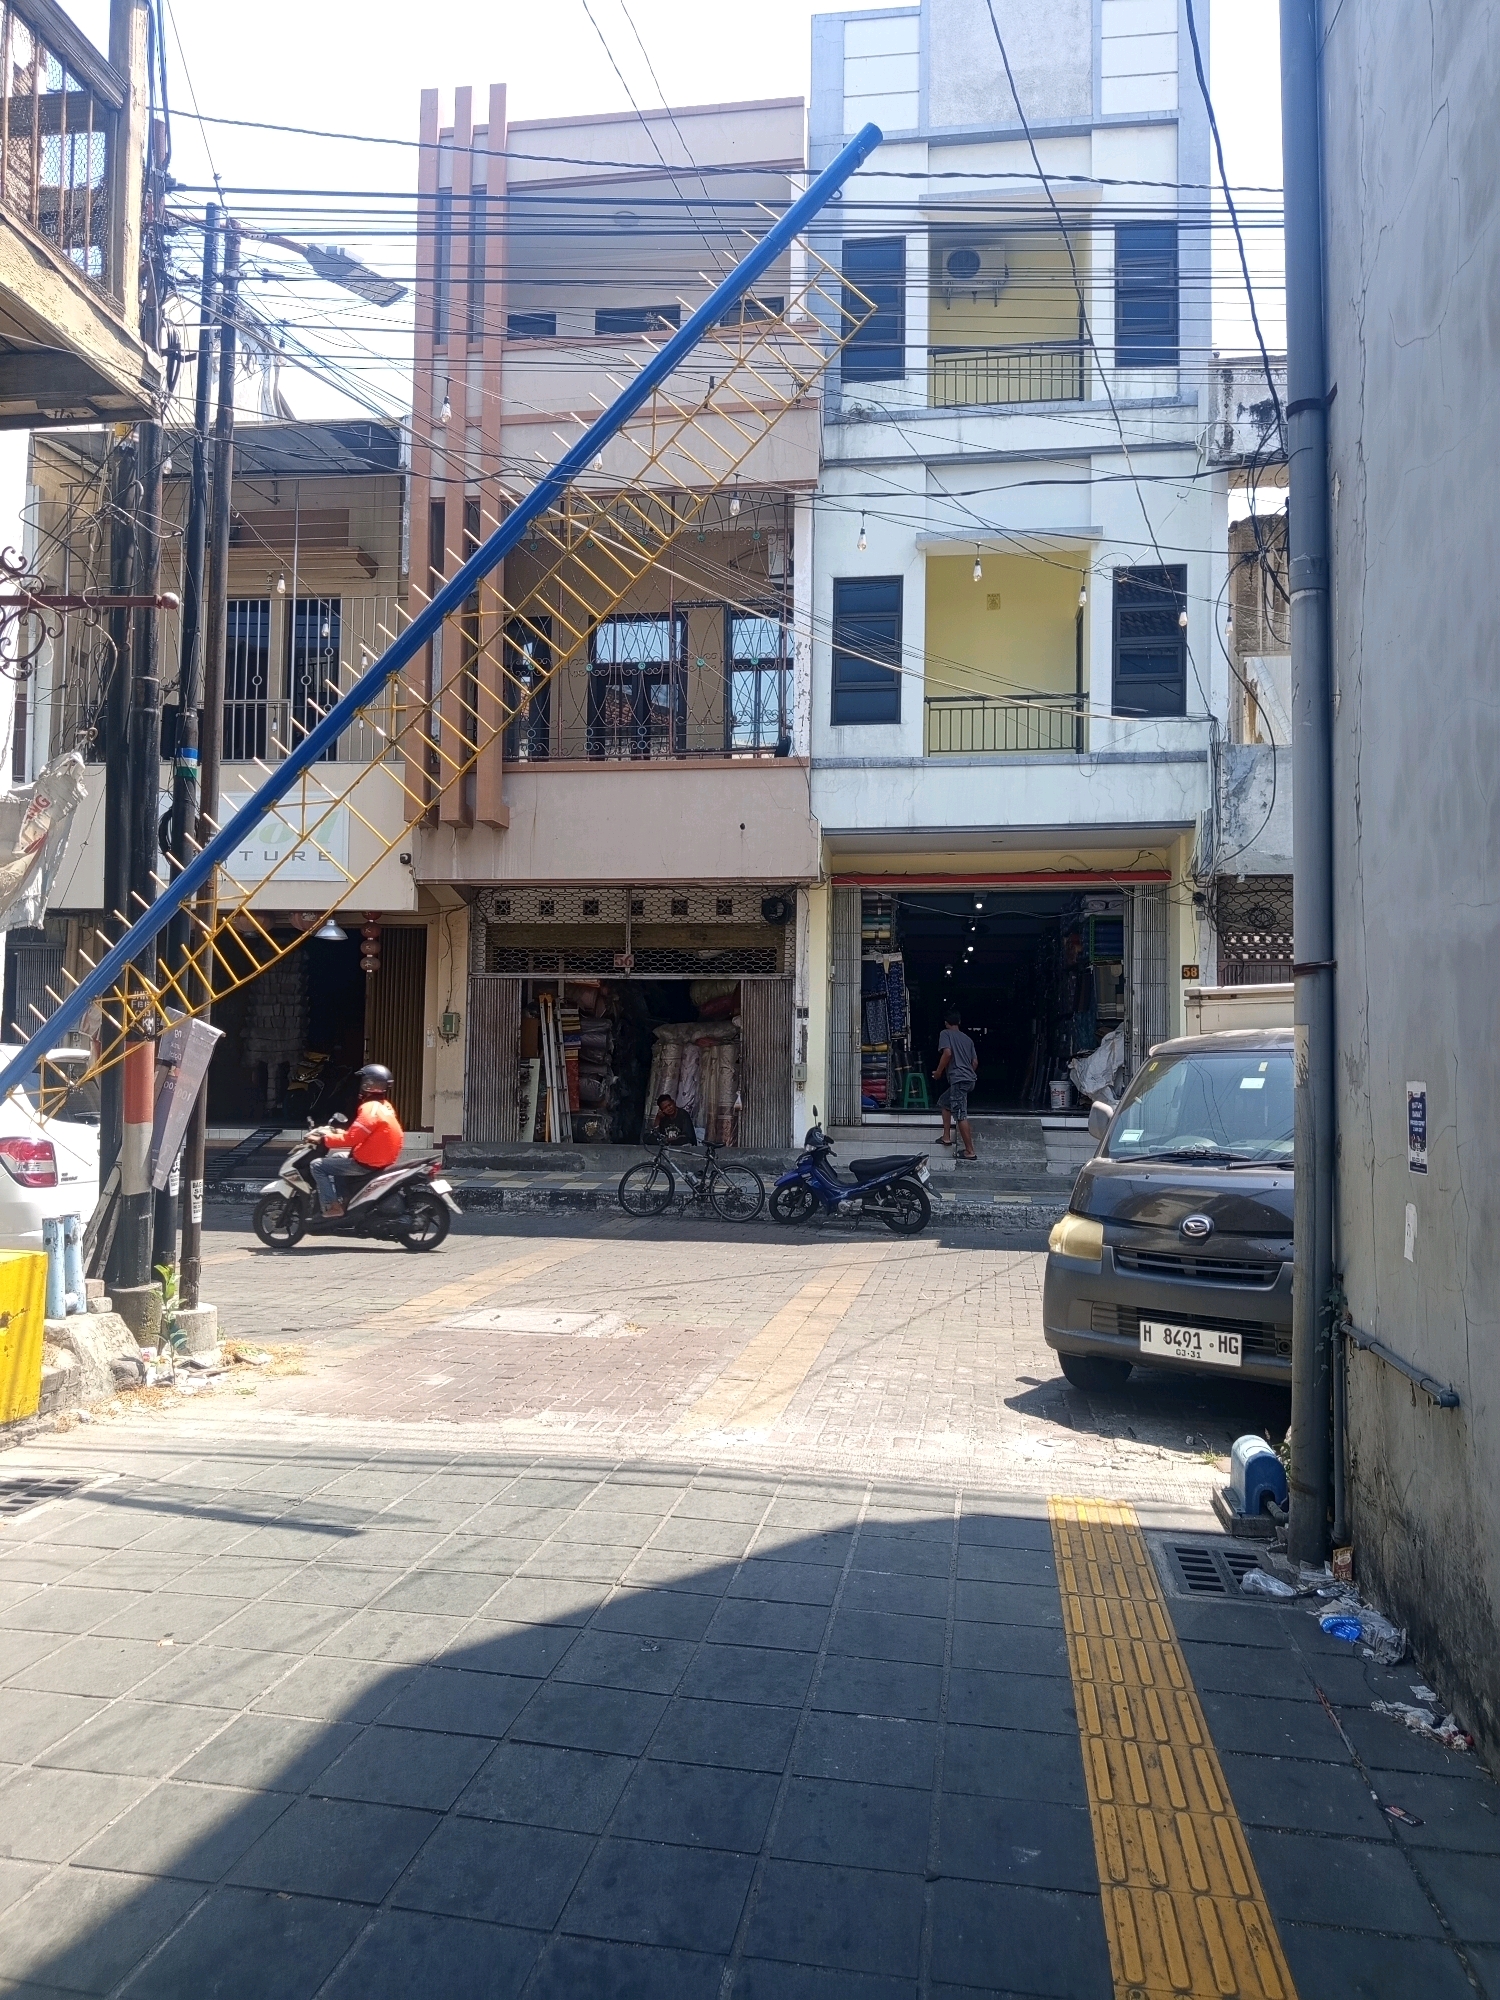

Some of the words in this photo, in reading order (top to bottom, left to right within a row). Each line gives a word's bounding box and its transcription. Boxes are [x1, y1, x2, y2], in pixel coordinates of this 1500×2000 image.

[238, 850, 332, 862] TURE
[615, 955, 633, 967] 56
[1183, 967, 1198, 978] 58
[1143, 1324, 1152, 1343] H
[1163, 1327, 1202, 1350] 8491
[1218, 1334, 1239, 1355] HG
